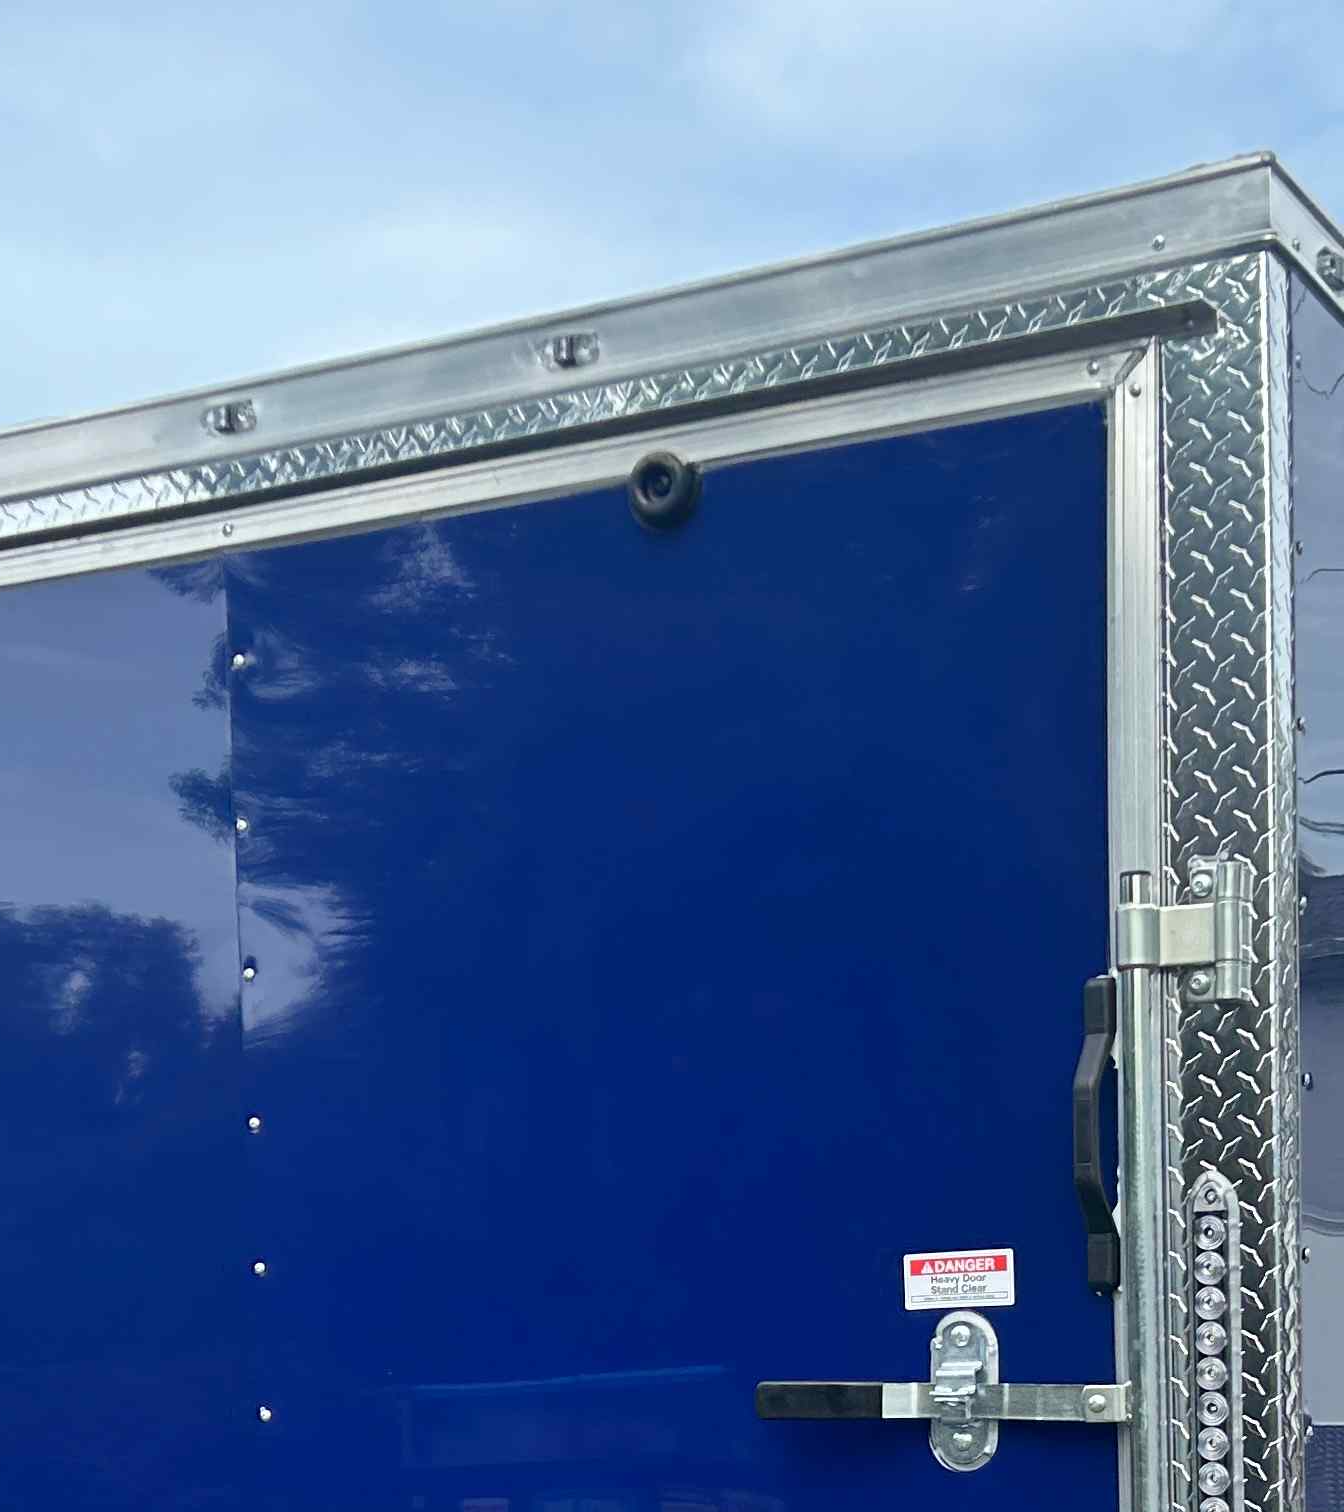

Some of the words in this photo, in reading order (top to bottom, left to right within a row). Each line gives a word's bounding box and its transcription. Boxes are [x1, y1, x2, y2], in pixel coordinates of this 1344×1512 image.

[935, 1258, 995, 1273] DANGER
[931, 1276, 959, 1285] Heavy
[963, 1274, 986, 1282] Door
[931, 1285, 958, 1295] Stand
[961, 1284, 986, 1293] Clear
